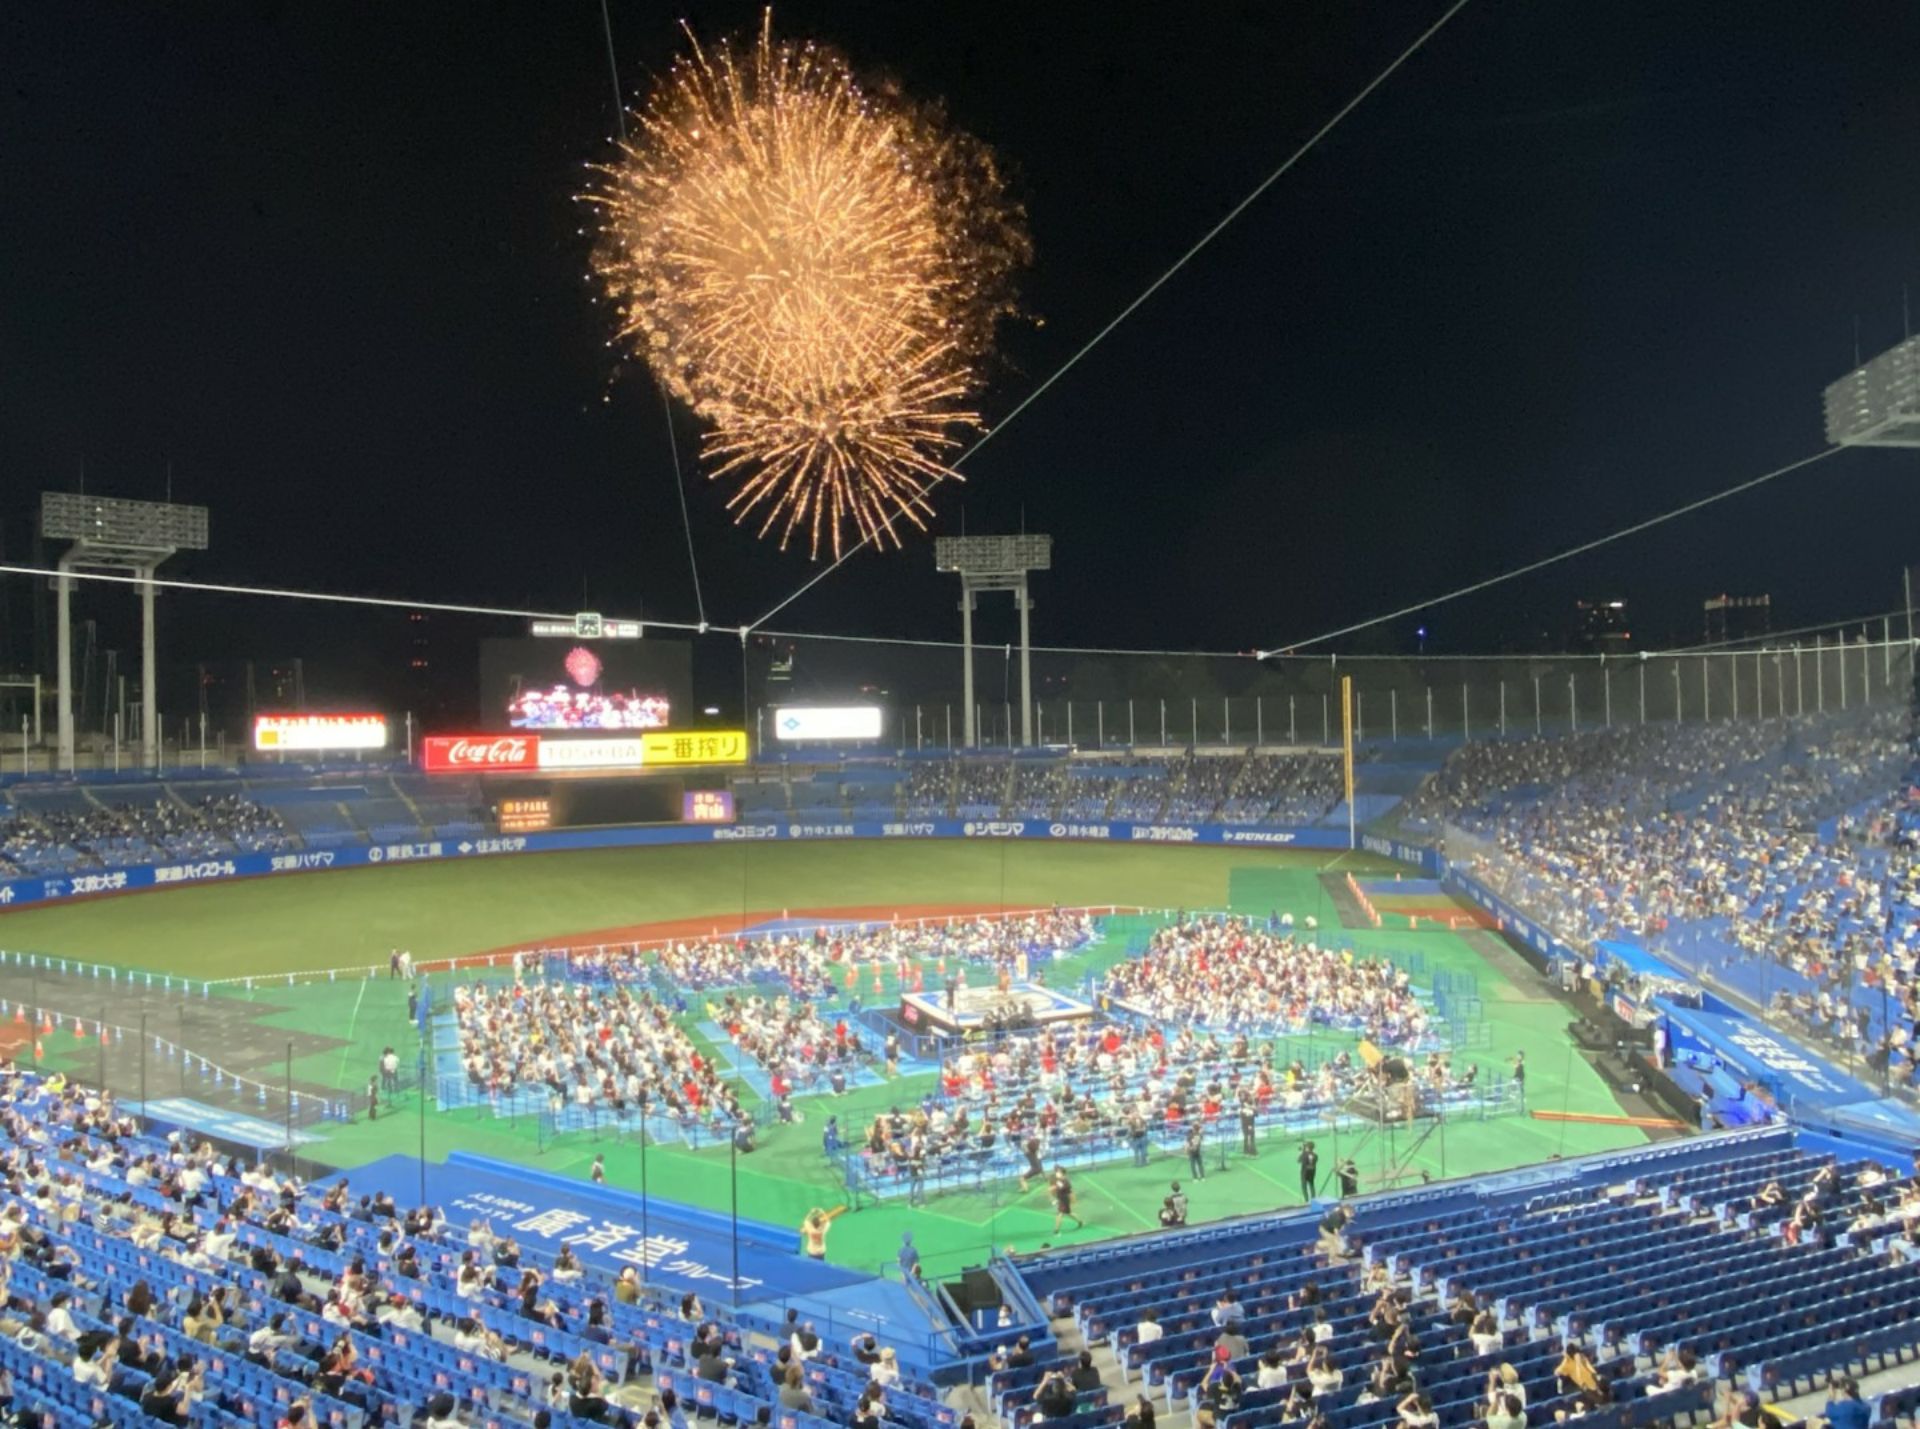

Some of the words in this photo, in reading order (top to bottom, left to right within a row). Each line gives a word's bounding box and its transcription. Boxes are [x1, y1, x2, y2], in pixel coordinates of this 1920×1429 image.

[547, 746, 637, 761] TOSHIBA
[650, 736, 739, 758] 一番搾り
[882, 823, 935, 836] 安藤ハザマ
[976, 823, 1024, 836] シモジマ
[1234, 832, 1295, 843] DUNLOP
[387, 842, 443, 860] 東鉄工業
[476, 838, 527, 854] 住友化学
[271, 851, 335, 870] 安藤ハザマ
[155, 860, 235, 883] 東進ハイスクール
[71, 871, 127, 894] 文教大学
